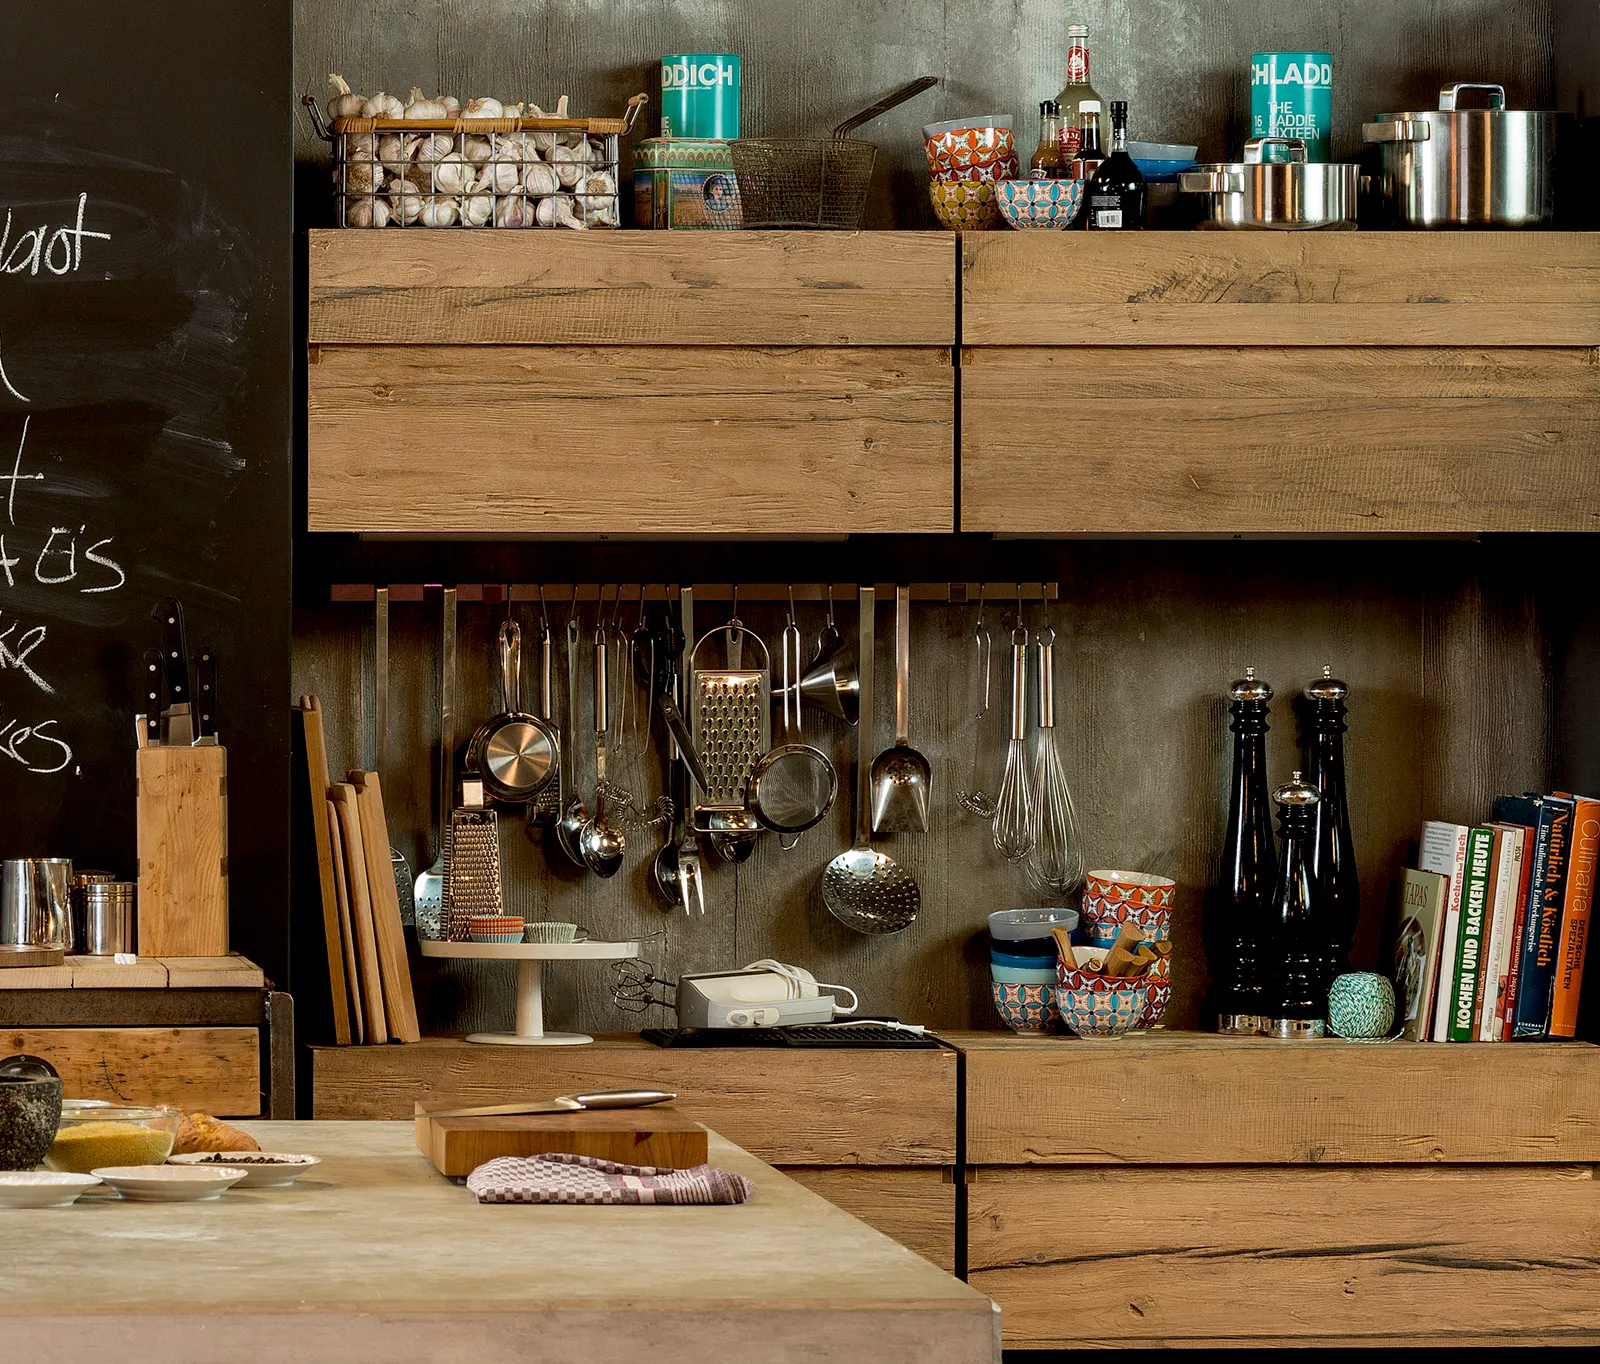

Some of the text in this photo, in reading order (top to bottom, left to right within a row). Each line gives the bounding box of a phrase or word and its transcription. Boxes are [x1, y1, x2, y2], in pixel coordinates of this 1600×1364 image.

[1254, 115, 1263, 128] 16
[1267, 101, 1293, 114] THE
[1269, 114, 1316, 127] LADDIE
[1268, 127, 1320, 140] SIXTEEN
[34, 524, 126, 594] Eis
[1455, 833, 1466, 863] Tisch
[1572, 819, 1600, 912] Culinaria
[1405, 881, 1429, 907] TAPAS
[1451, 872, 1463, 913] Kochen
[1527, 824, 1549, 953] Eine kulinarische Entdeckungsreise
[1537, 812, 1569, 967] Natürlich & Köstlich
[1456, 834, 1490, 1029] KOCHEN UND BACKEN HEUTE
[1512, 925, 1523, 975] Hausmannskost
[1574, 919, 1586, 970] DEUTSCHE
[1563, 919, 1577, 990] SPEZIALITÄTEN
[1508, 975, 1518, 1001] Leichte
